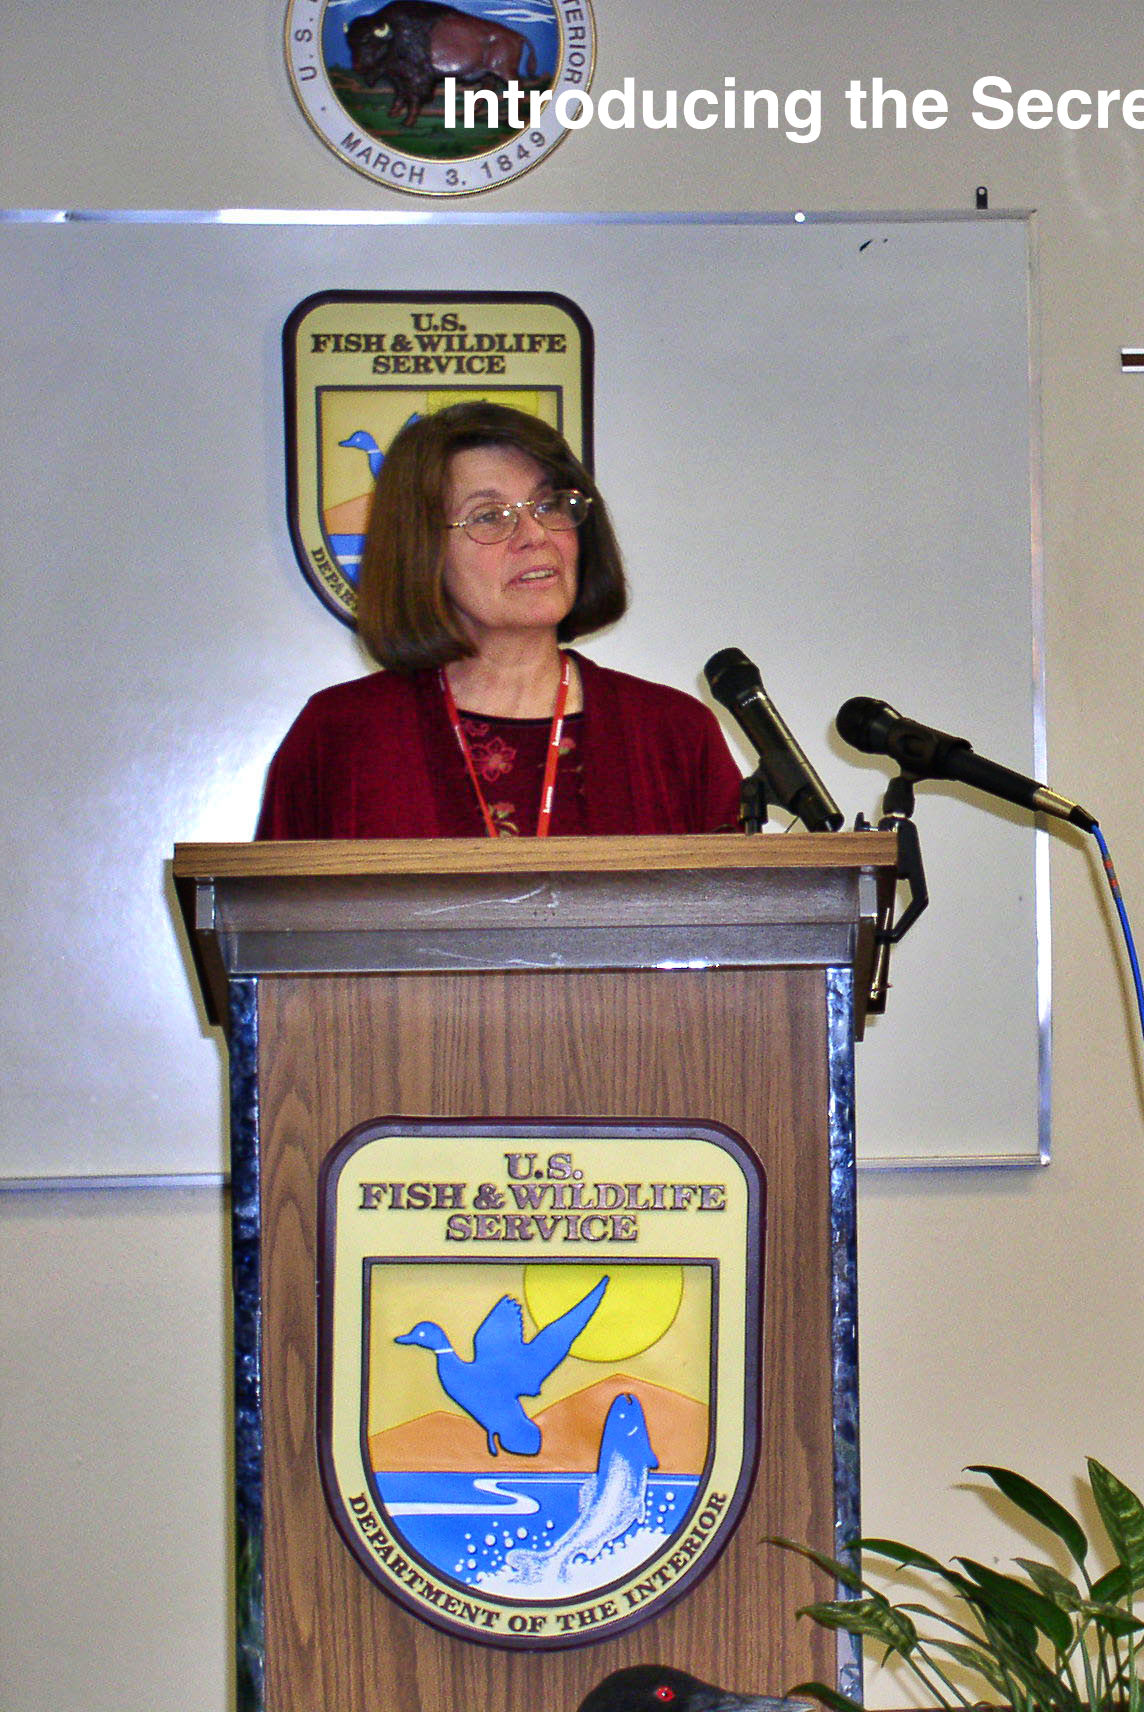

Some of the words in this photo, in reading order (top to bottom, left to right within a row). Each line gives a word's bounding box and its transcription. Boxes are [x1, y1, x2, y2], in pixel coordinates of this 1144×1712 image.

[340, 131, 425, 185] MARCH
[480, 131, 546, 179] 1849
[411, 313, 467, 332] U.S.
[311, 333, 387, 354] FISH
[391, 335, 413, 353] &
[415, 334, 567, 354] WILDLIFE
[372, 355, 506, 375] SERVICE
[504, 1153, 584, 1180] U.S.
[359, 1183, 467, 1210] FISH
[472, 1184, 505, 1210] &
[508, 1183, 727, 1211] WILDLIFE
[445, 1214, 639, 1242] SERVICE
[348, 1492, 500, 1628] DEPARTMENT
[508, 1616, 548, 1634] OF
[556, 1599, 620, 1632] THE
[624, 1492, 728, 1609] INTERIOR
